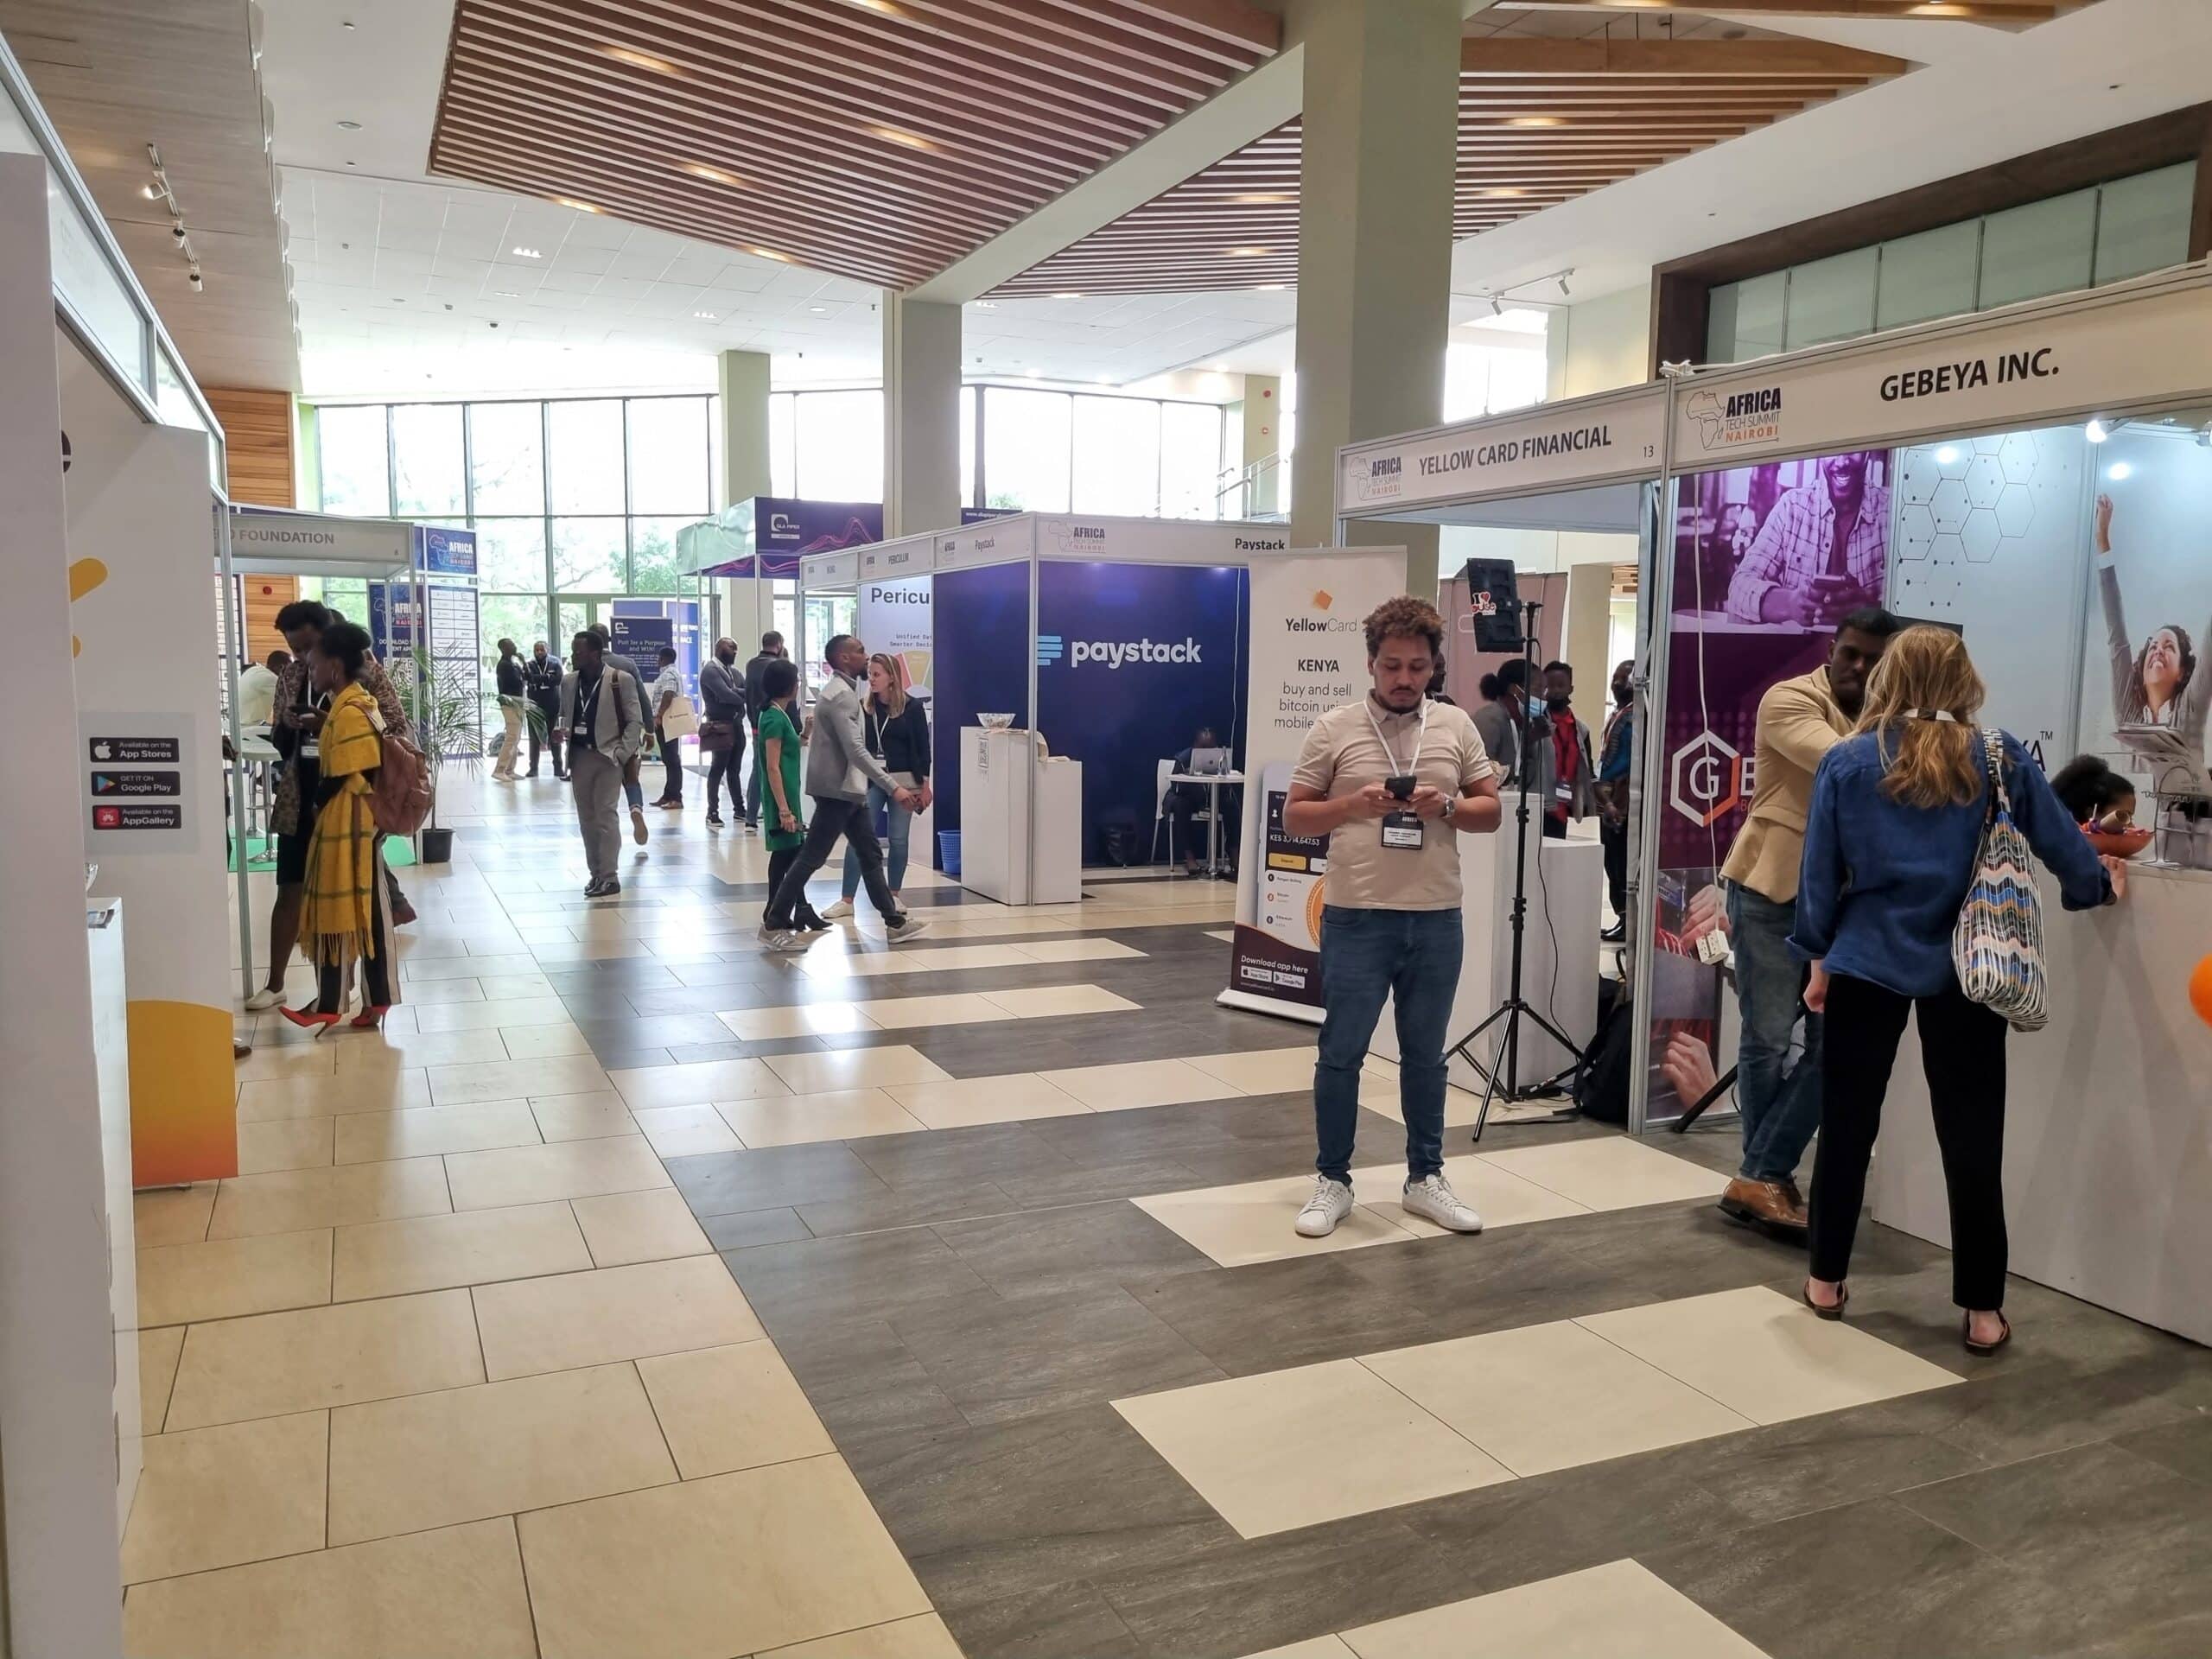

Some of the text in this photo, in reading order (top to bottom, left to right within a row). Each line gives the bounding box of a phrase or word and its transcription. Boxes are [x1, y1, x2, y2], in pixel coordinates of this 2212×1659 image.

[1880, 347, 2059, 402] GEBEYA INC.
[1726, 387, 1781, 418] AFRICA
[1726, 410, 1781, 430] TECH SUMMIT
[1726, 425, 1778, 442] NAIROBI
[1420, 425, 1611, 476] YELLOW CARD FINANCIAL
[1643, 445, 1655, 458] 13
[1371, 456, 1402, 477] AFRICA
[239, 530, 334, 544] FOUNDATION
[1073, 527, 1105, 539] AFRICA
[1235, 537, 1285, 550] Paystack
[395, 602, 422, 613] AFRIA
[1286, 618, 1357, 632] YellowCard
[1071, 637, 1202, 669] paystack
[1298, 659, 1339, 672] KENYA
[1283, 681, 1351, 698] buy and sell
[1279, 698, 1319, 712] bitcoin
[1274, 715, 1313, 729] mobile
[119, 750, 139, 759] App
[121, 784, 171, 792] Google Play
[1270, 834, 1282, 842] KES
[1241, 955, 1276, 968] Download
[1276, 963, 1291, 971] app
[1292, 963, 1309, 974] here
